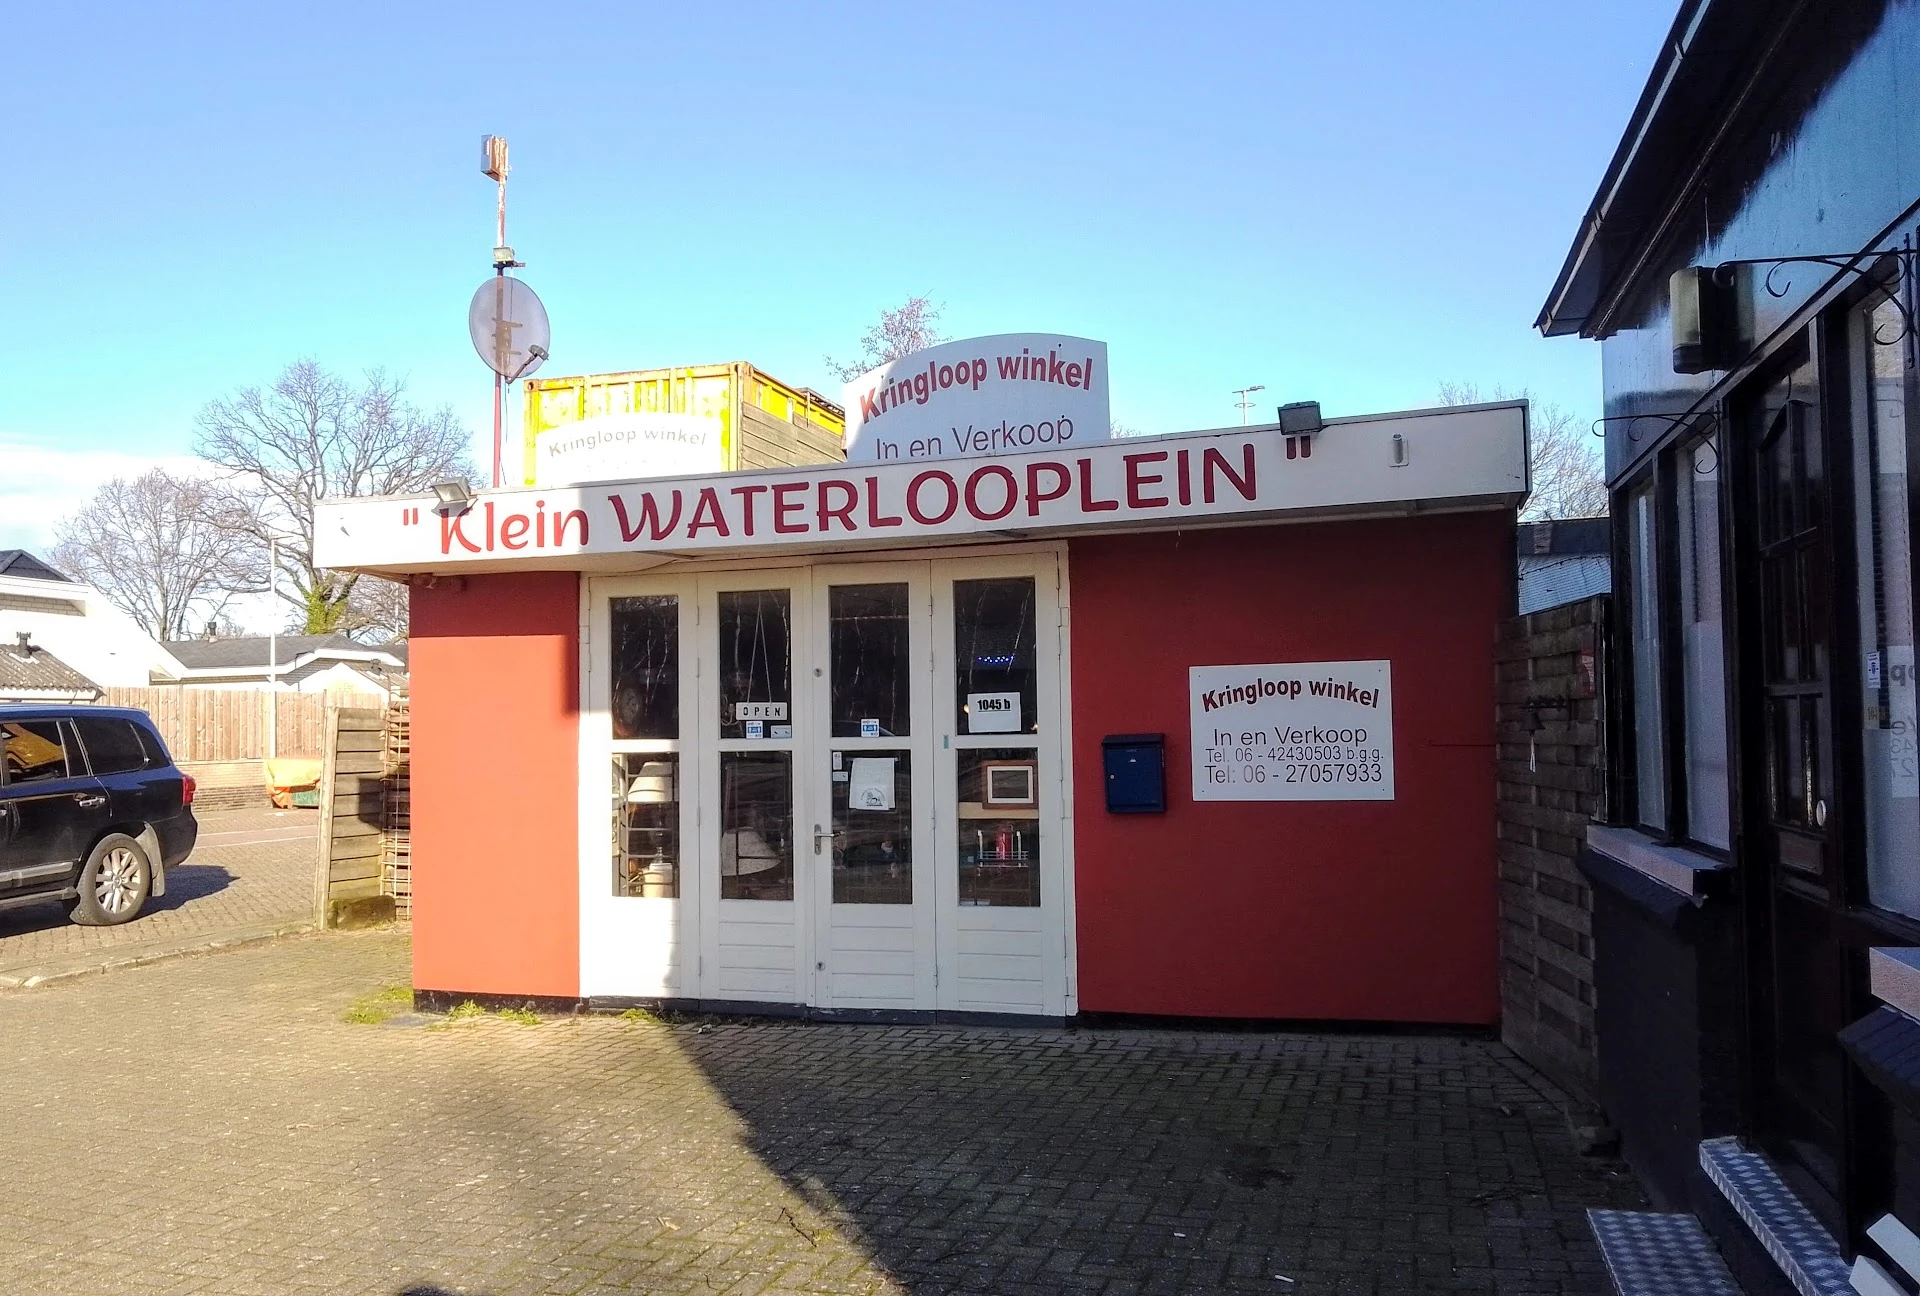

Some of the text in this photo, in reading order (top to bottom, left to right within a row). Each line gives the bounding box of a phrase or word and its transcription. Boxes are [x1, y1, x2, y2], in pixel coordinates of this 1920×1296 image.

[860, 348, 1092, 424] Kringloop winkel
[549, 428, 707, 457] Kringloop winkel
[876, 416, 1074, 460] In en Verkoop
[440, 500, 589, 555] Klein
[608, 443, 1257, 542] WATERLOOPLEIN
[977, 699, 1002, 711] 1045
[1202, 678, 1379, 712] Kringloop winkel
[743, 706, 781, 716] OPEN
[1214, 726, 1367, 747] In en Verkoop
[1235, 748, 1252, 762] 06
[1267, 745, 1341, 762] 42430503
[1347, 746, 1384, 762] b.g.g.
[1243, 765, 1266, 783] 06
[1286, 763, 1382, 783] 27057933
